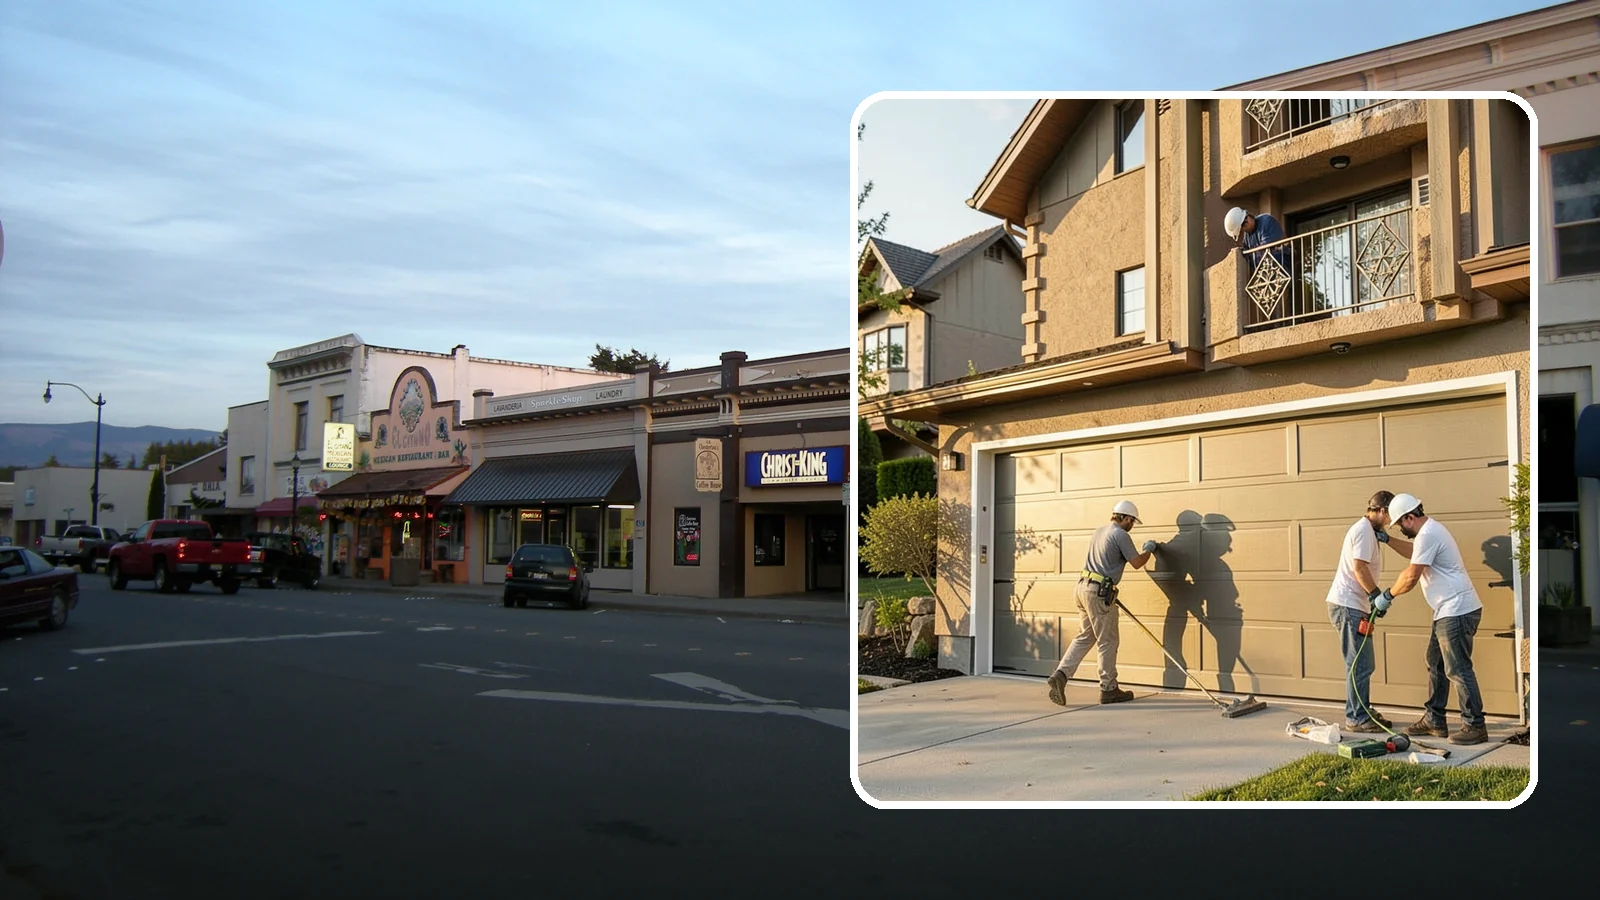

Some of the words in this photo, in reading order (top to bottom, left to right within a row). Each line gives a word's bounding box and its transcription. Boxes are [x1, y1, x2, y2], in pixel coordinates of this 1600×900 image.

[493, 402, 522, 412] LAVANDERIA
[530, 398, 561, 409] Sparkle
[562, 394, 582, 405] Shop
[595, 389, 623, 400] LAUNDRY
[373, 454, 396, 464] MEXICAN
[397, 451, 433, 462] RESTAURANT
[438, 450, 450, 459] BAR
[760, 452, 797, 477] CHRIST
[799, 450, 827, 476] KING
